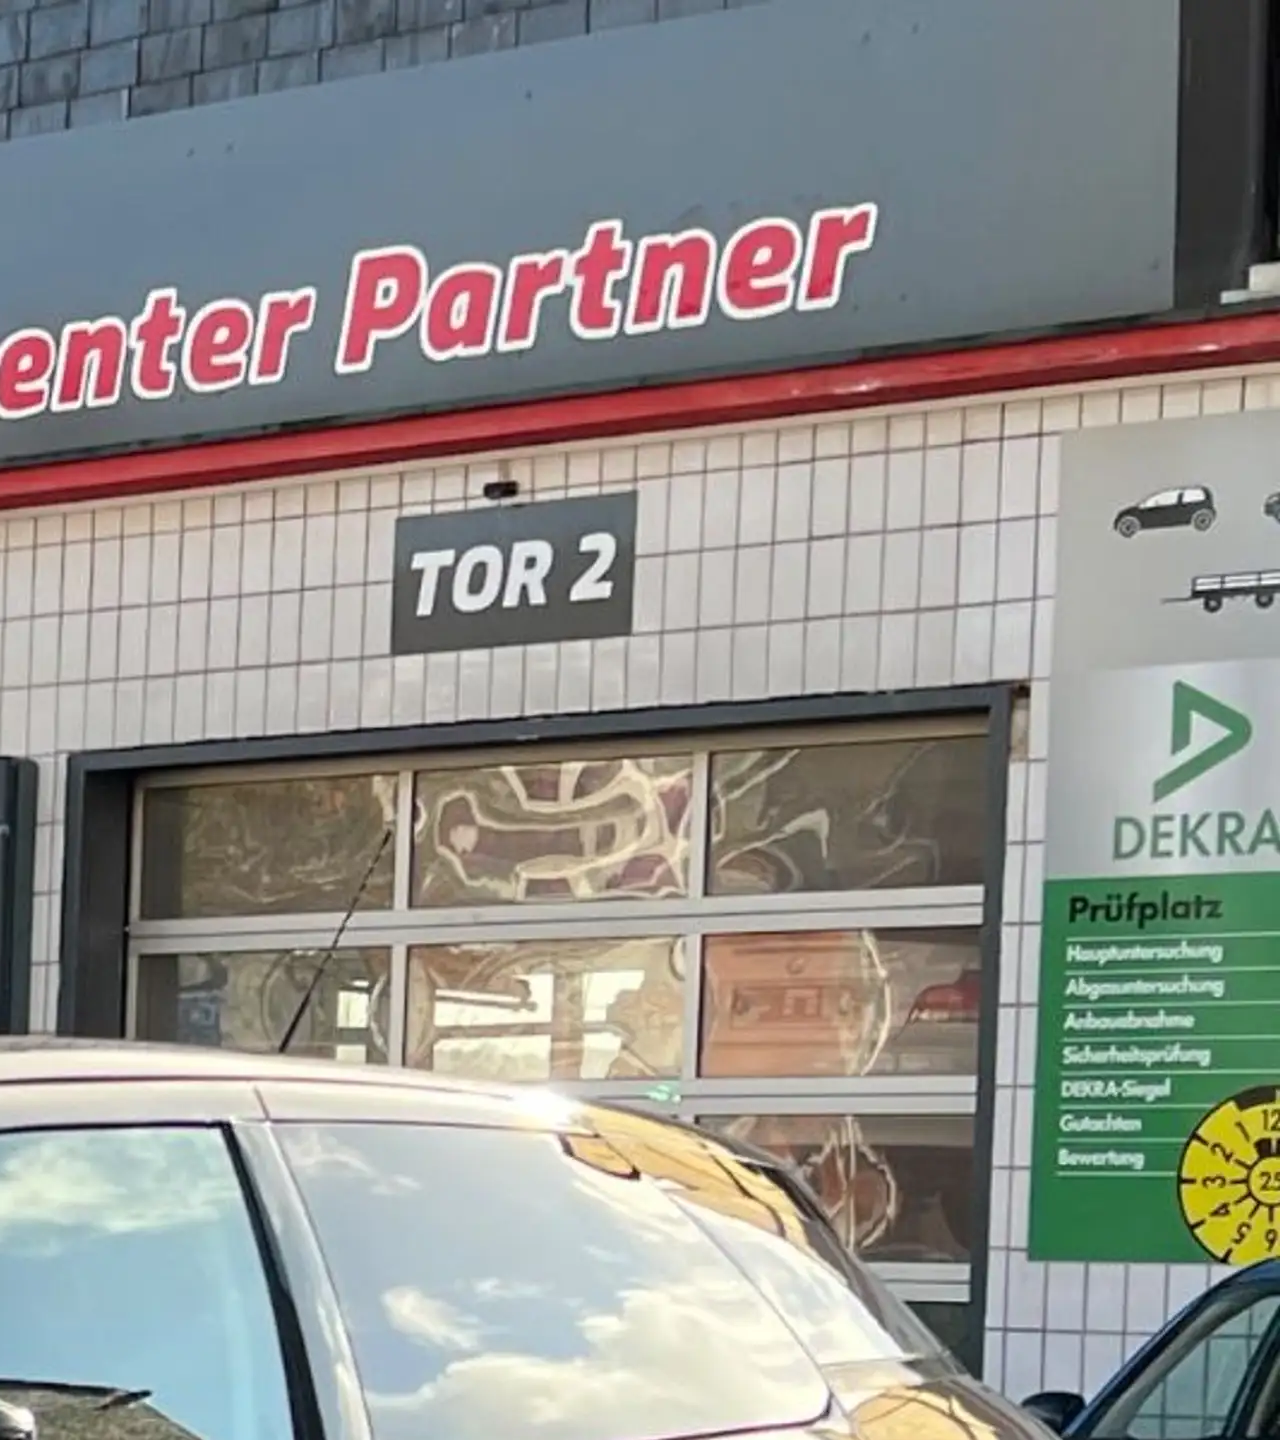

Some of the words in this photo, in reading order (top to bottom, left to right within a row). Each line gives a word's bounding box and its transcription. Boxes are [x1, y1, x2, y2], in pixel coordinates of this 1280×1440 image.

[335, 201, 878, 376] Partner
[409, 538, 553, 619] TOR
[569, 532, 618, 602] 2
[1113, 808, 1280, 863] DEKRA
[1068, 890, 1224, 930] Prüfplatz
[1066, 940, 1224, 968] Hauptuntersuchung
[1064, 974, 1226, 1001] Abgasuntersuchung
[1062, 1042, 1212, 1067] Sicherheitsprüfung
[1060, 1076, 1172, 1103] DEKRA-Siegel
[1059, 1113, 1143, 1132] Gutachten
[1057, 1148, 1145, 1170] Bewertung
